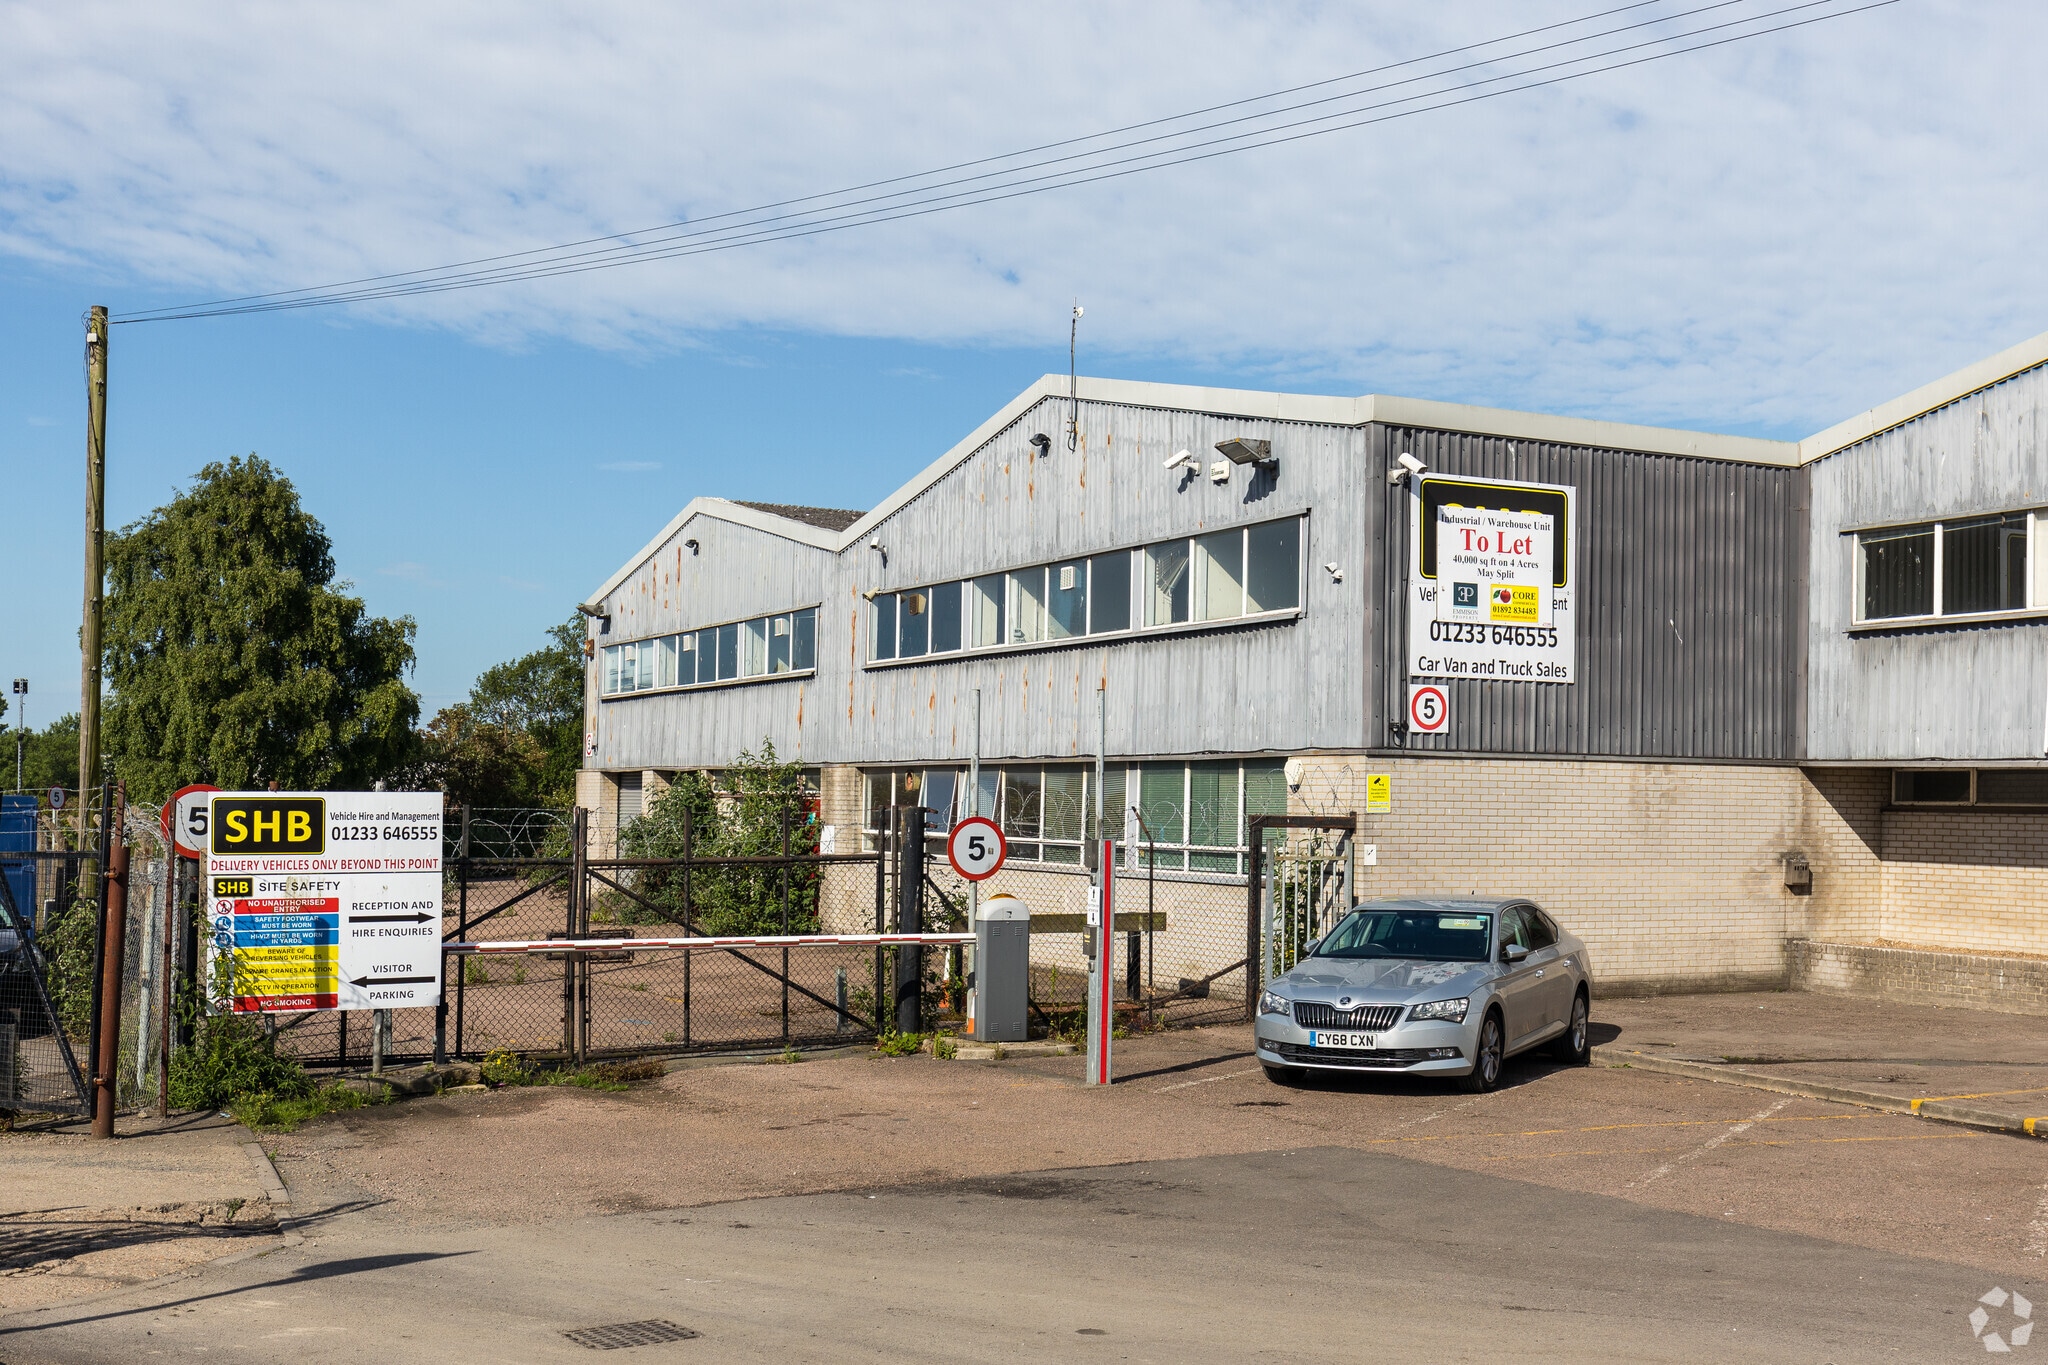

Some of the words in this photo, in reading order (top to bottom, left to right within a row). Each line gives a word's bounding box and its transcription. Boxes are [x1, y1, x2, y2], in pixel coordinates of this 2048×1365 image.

[1441, 513, 1481, 526] Industrial
[1487, 517, 1532, 529] Warehouse
[1533, 521, 1551, 531] Unit
[1460, 528, 1489, 552] To
[1496, 531, 1533, 555] Let
[1453, 554, 1478, 565] 40,000
[1479, 558, 1489, 567] sq
[1490, 556, 1497, 566] ft
[1498, 559, 1509, 567] on
[1510, 558, 1515, 567] 4
[1517, 559, 1539, 569] Acres
[1477, 567, 1494, 578] May
[1496, 569, 1515, 580] Split
[1512, 591, 1536, 600] CORE
[1492, 605, 1512, 614] 01892
[1513, 606, 1537, 615] 834483
[1430, 620, 1486, 644] 01233
[1492, 624, 1558, 648] 646555
[1418, 655, 1440, 672] Car
[1443, 657, 1467, 673] Van
[1471, 659, 1495, 675] and
[1498, 660, 1533, 676] Truck
[1536, 661, 1567, 678] Sales
[1423, 698, 1436, 719] 5
[53, 791, 60, 802] 5
[188, 806, 208, 836] 5
[330, 811, 357, 821] Vehicle
[358, 812, 374, 821] Hire
[375, 812, 390, 821] and
[391, 811, 440, 822] Management
[225, 810, 312, 843] SHB
[331, 826, 378, 841] 01233
[383, 826, 438, 840] 646555
[968, 836, 985, 861] 5
[211, 860, 260, 871] DELIVERY
[262, 859, 309, 871] VEHICLES
[312, 859, 338, 870] ONLY
[340, 859, 381, 870] BEYOND
[384, 858, 407, 869] THIS
[408, 858, 439, 869] POINT
[217, 881, 249, 894] SHB
[259, 882, 287, 892] SITE
[291, 881, 341, 891] SAFETY
[352, 901, 408, 910] RECEPTION
[411, 901, 434, 909] AND
[352, 929, 376, 937] HIRE
[378, 927, 433, 937] ENQUIRIES
[372, 964, 413, 973] VISITOR
[369, 990, 414, 1000] PARKING
[1317, 1033, 1347, 1046] CY68
[1350, 1034, 1374, 1047] CXN
